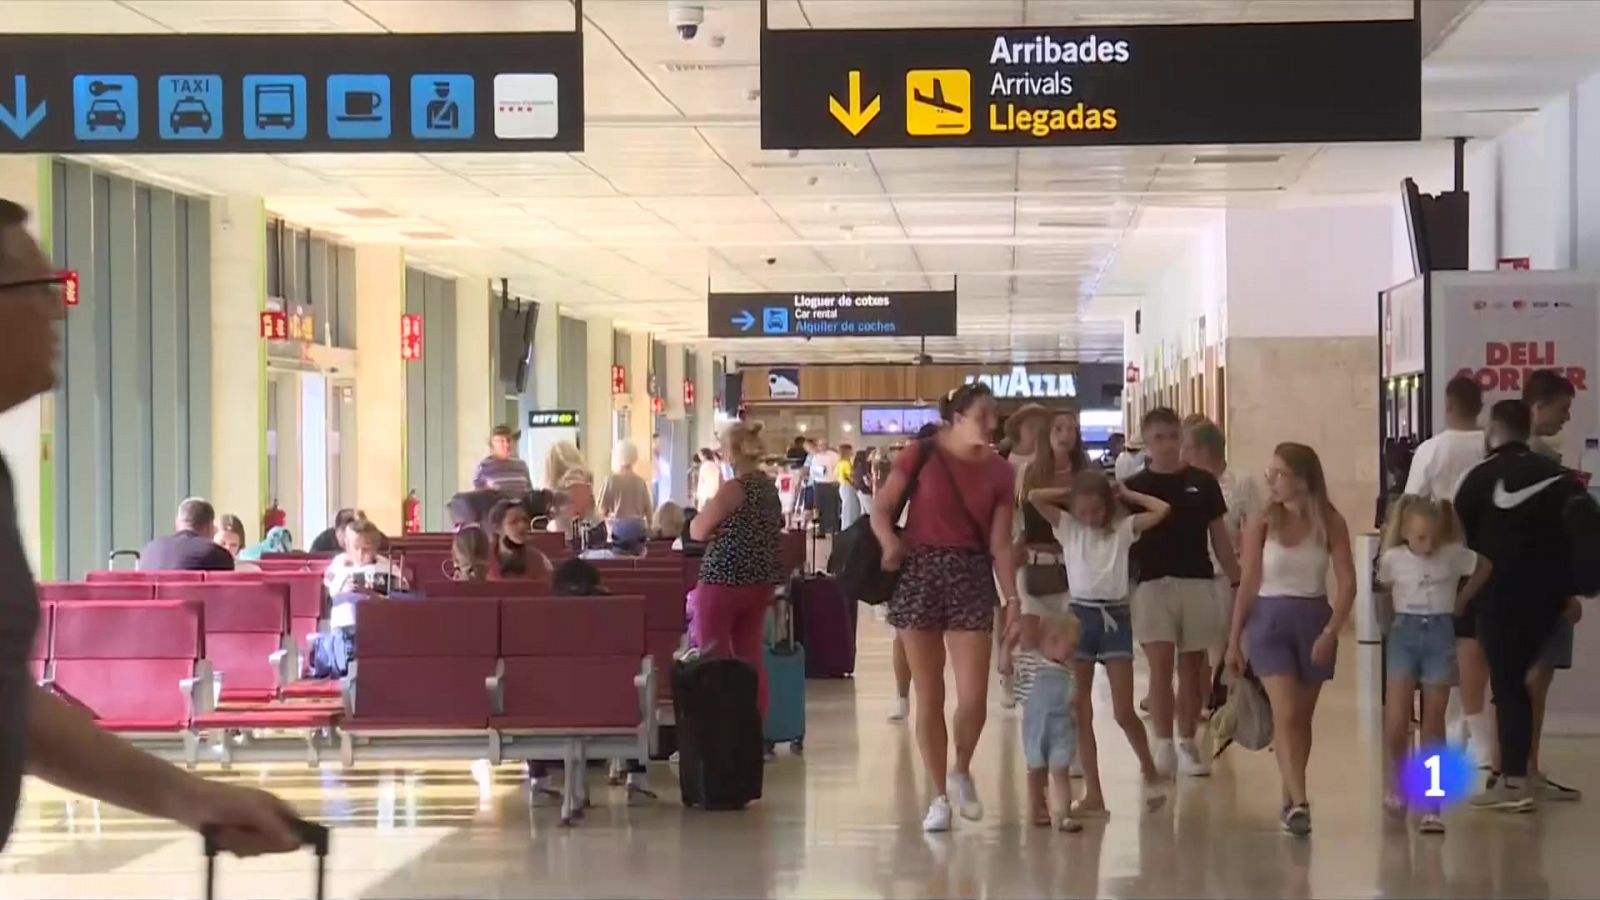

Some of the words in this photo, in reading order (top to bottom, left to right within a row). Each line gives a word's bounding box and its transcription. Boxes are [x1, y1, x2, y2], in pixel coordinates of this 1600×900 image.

[990, 35, 1129, 64] Arribades
[171, 79, 209, 93] TAXI
[990, 70, 1073, 95] Arrivals
[990, 103, 1117, 136] Llegadas
[794, 295, 835, 308] Lloguer
[838, 295, 852, 307] de
[855, 295, 890, 307] cotxes
[794, 308, 811, 319] Car
[813, 308, 838, 319] rental
[796, 319, 838, 333] Alquiler
[841, 319, 854, 332] de
[858, 319, 896, 332] coches
[1486, 341, 1555, 366] DELI
[1456, 367, 1587, 391] ORR
